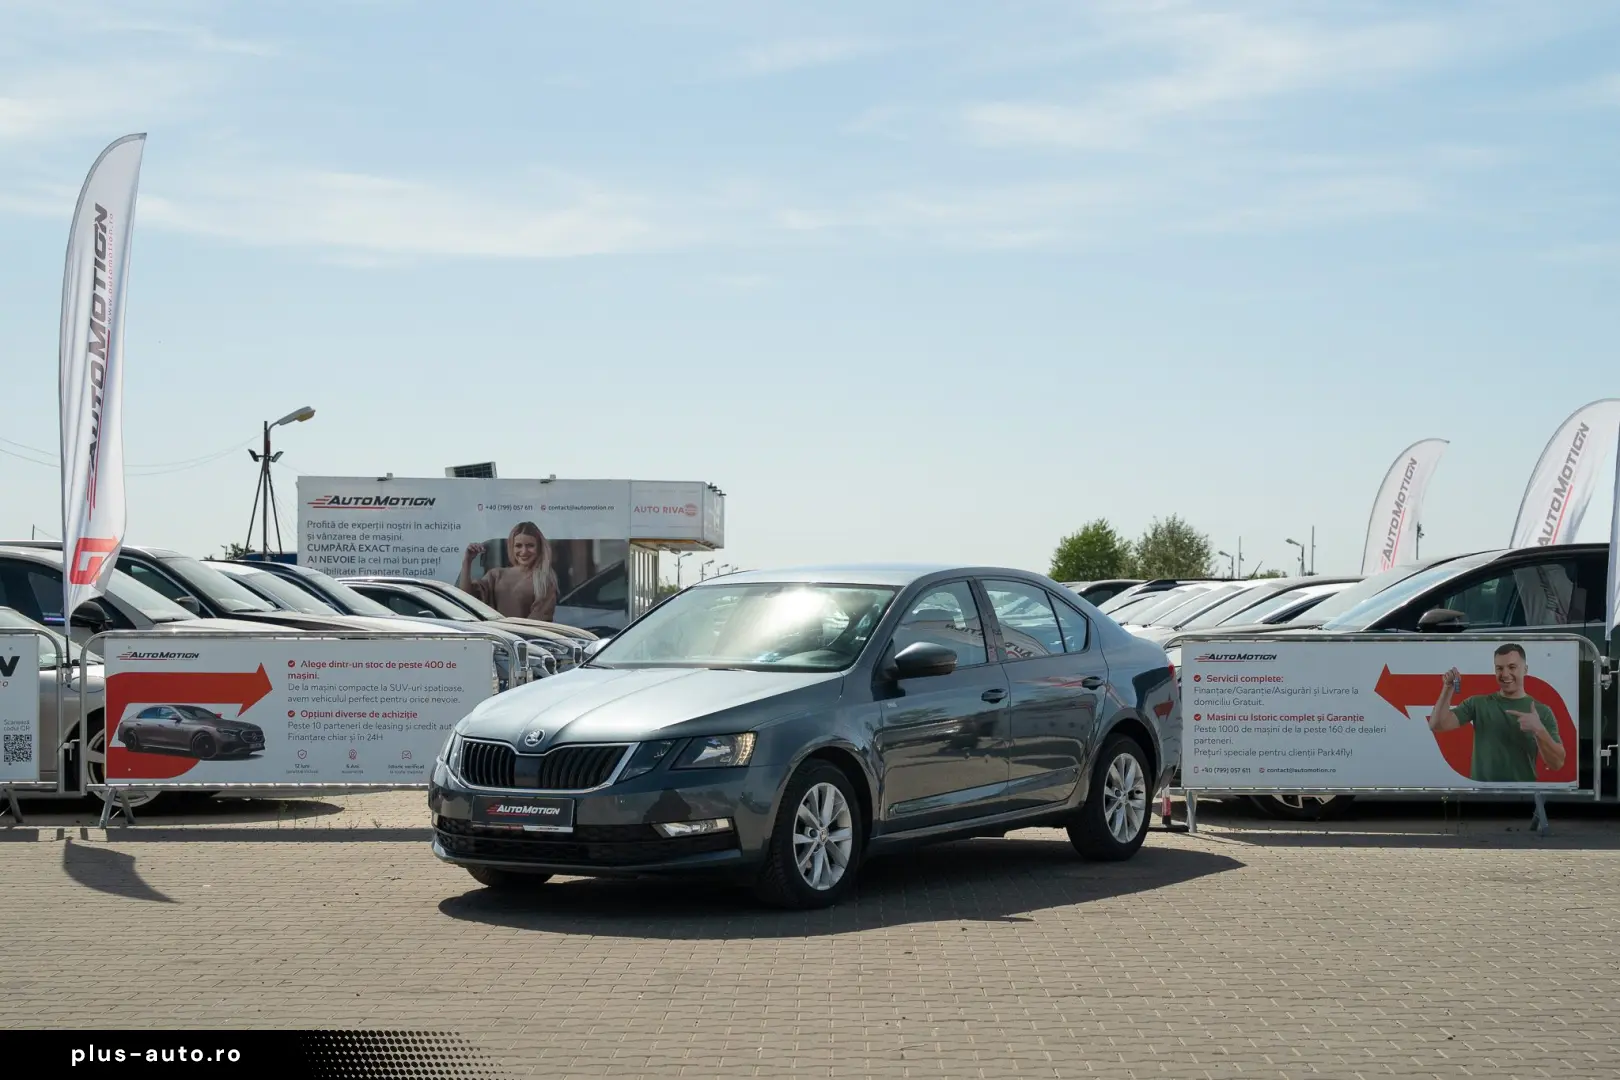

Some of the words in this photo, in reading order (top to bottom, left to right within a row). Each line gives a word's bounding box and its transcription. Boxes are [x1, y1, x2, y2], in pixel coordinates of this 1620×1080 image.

[1536, 422, 1590, 547] AUTOMOTION
[328, 496, 436, 506] AUTOMOTION
[548, 504, 614, 512] contact@automotion.ro
[663, 506, 685, 514] RIVA
[1384, 457, 1417, 562] AUTOMOTION
[307, 521, 335, 529] Profită
[338, 521, 348, 529] de
[352, 521, 384, 531] experții
[387, 522, 411, 531] noștri
[425, 522, 461, 531] achiziția
[307, 534, 314, 542] și
[307, 543, 356, 552] CUMPĂRĂ
[393, 545, 424, 554] mașina
[358, 556, 366, 564] la
[369, 556, 380, 564] cel
[384, 556, 399, 564] mai
[402, 556, 418, 564] bun
[309, 567, 356, 575] sibilitate
[446, 661, 457, 669] de
[288, 672, 319, 681] mașini.
[1241, 675, 1283, 685] complete:
[311, 684, 336, 693] mașini
[339, 685, 378, 693] compacte
[1314, 687, 1320, 696] și
[312, 695, 346, 703] vehiculul
[349, 696, 378, 705] perfect
[381, 696, 407, 705] pentru
[1194, 698, 1230, 706] domiciliu
[1233, 698, 1264, 706] Gratuit.
[301, 710, 333, 719] Opțiuni
[382, 711, 418, 719] achiziție
[1280, 714, 1315, 723] complet
[1317, 714, 1325, 723] și
[1327, 714, 1364, 723] Garanție
[324, 722, 360, 731] parteneri
[376, 722, 403, 731] leasing
[406, 723, 412, 731] și
[1194, 725, 1216, 733] Peste
[1254, 726, 1280, 735] mașini
[1304, 727, 1326, 735] peste
[1194, 737, 1233, 746] parteneri.
[1194, 748, 1222, 758] Prețuri
[1224, 749, 1256, 758] speciale
[1259, 750, 1286, 758] pentru
[1288, 749, 1315, 758] clienții
[1318, 749, 1353, 758] Park4fly!
[497, 805, 560, 815] AUTOMOTION
